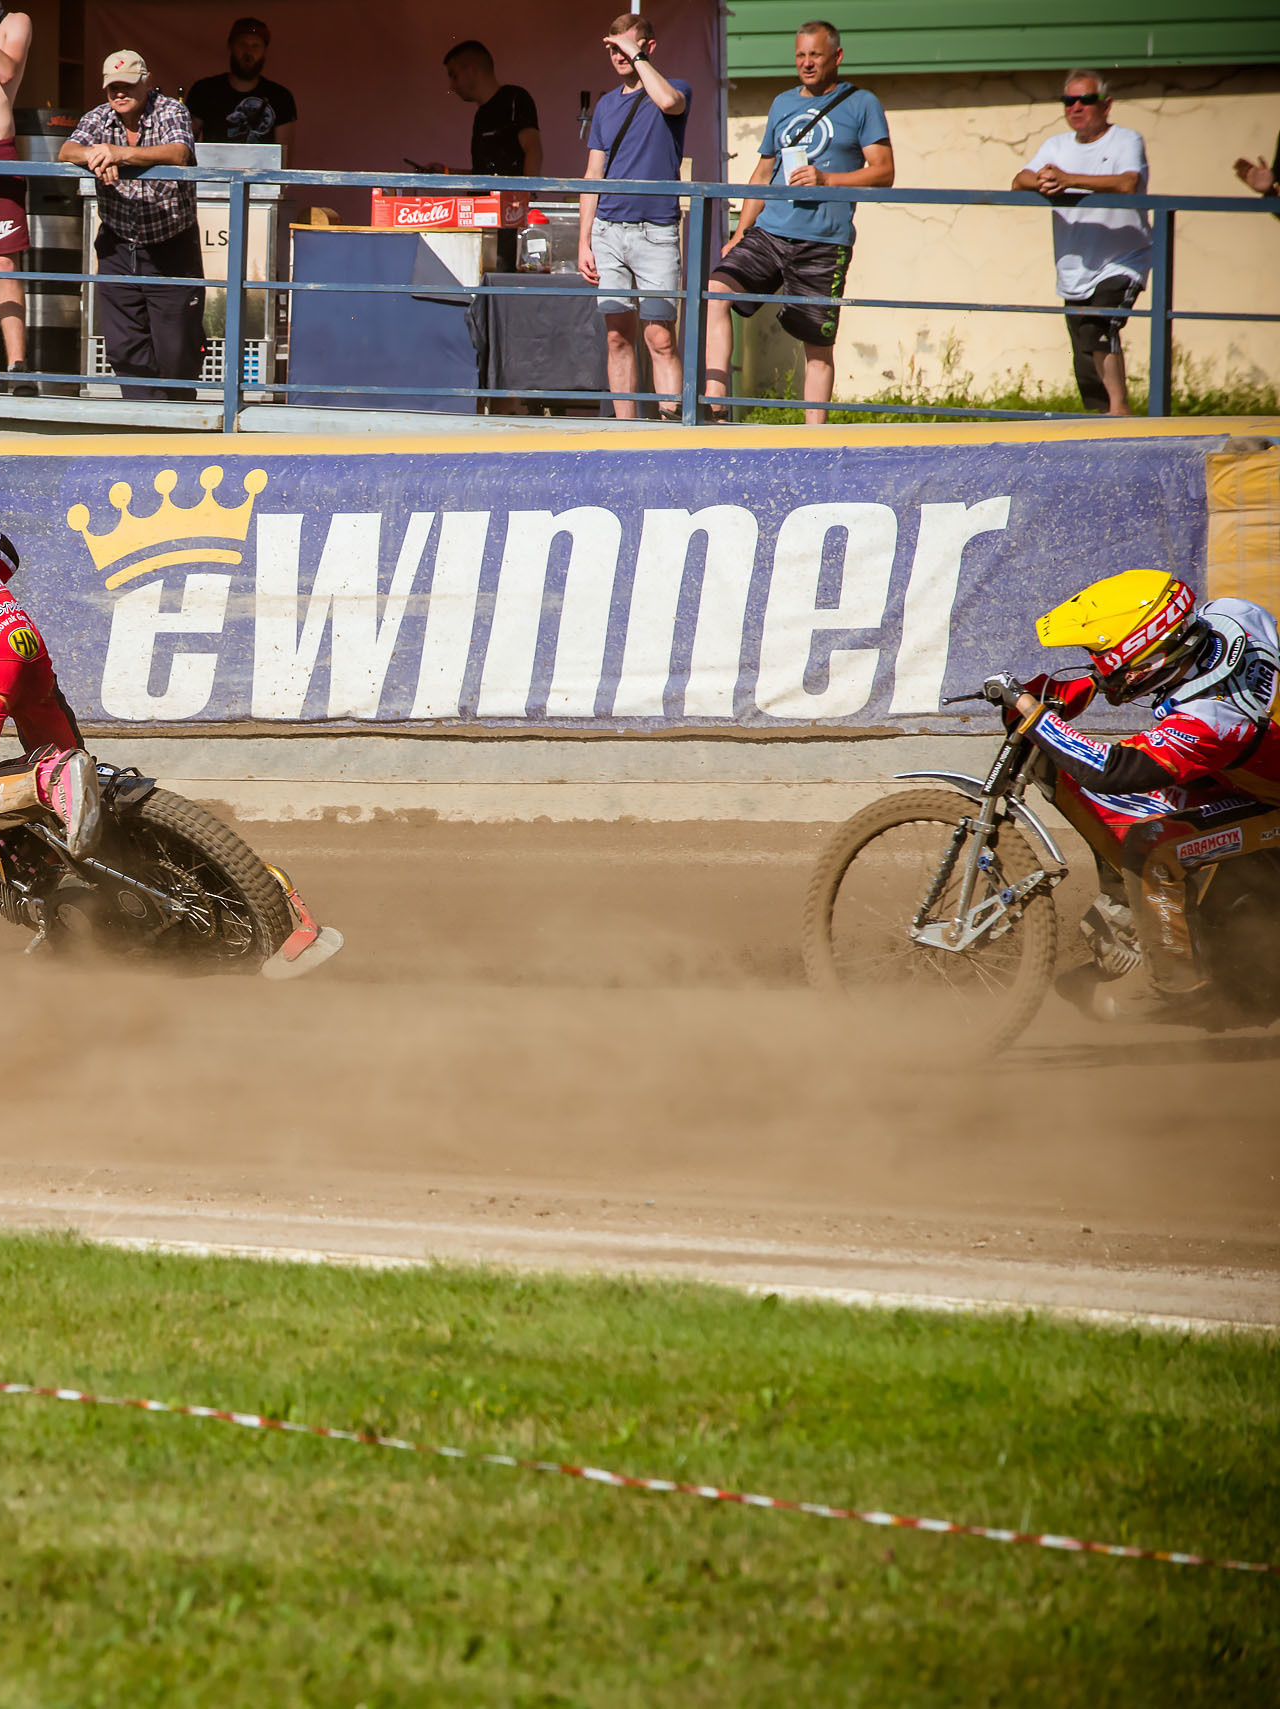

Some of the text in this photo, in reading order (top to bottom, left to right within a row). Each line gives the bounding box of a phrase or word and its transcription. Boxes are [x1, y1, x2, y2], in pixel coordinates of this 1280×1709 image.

[397, 204, 449, 224] Estrella
[11, 630, 39, 659] HN
[1179, 830, 1241, 859] ABRAMCZYK
